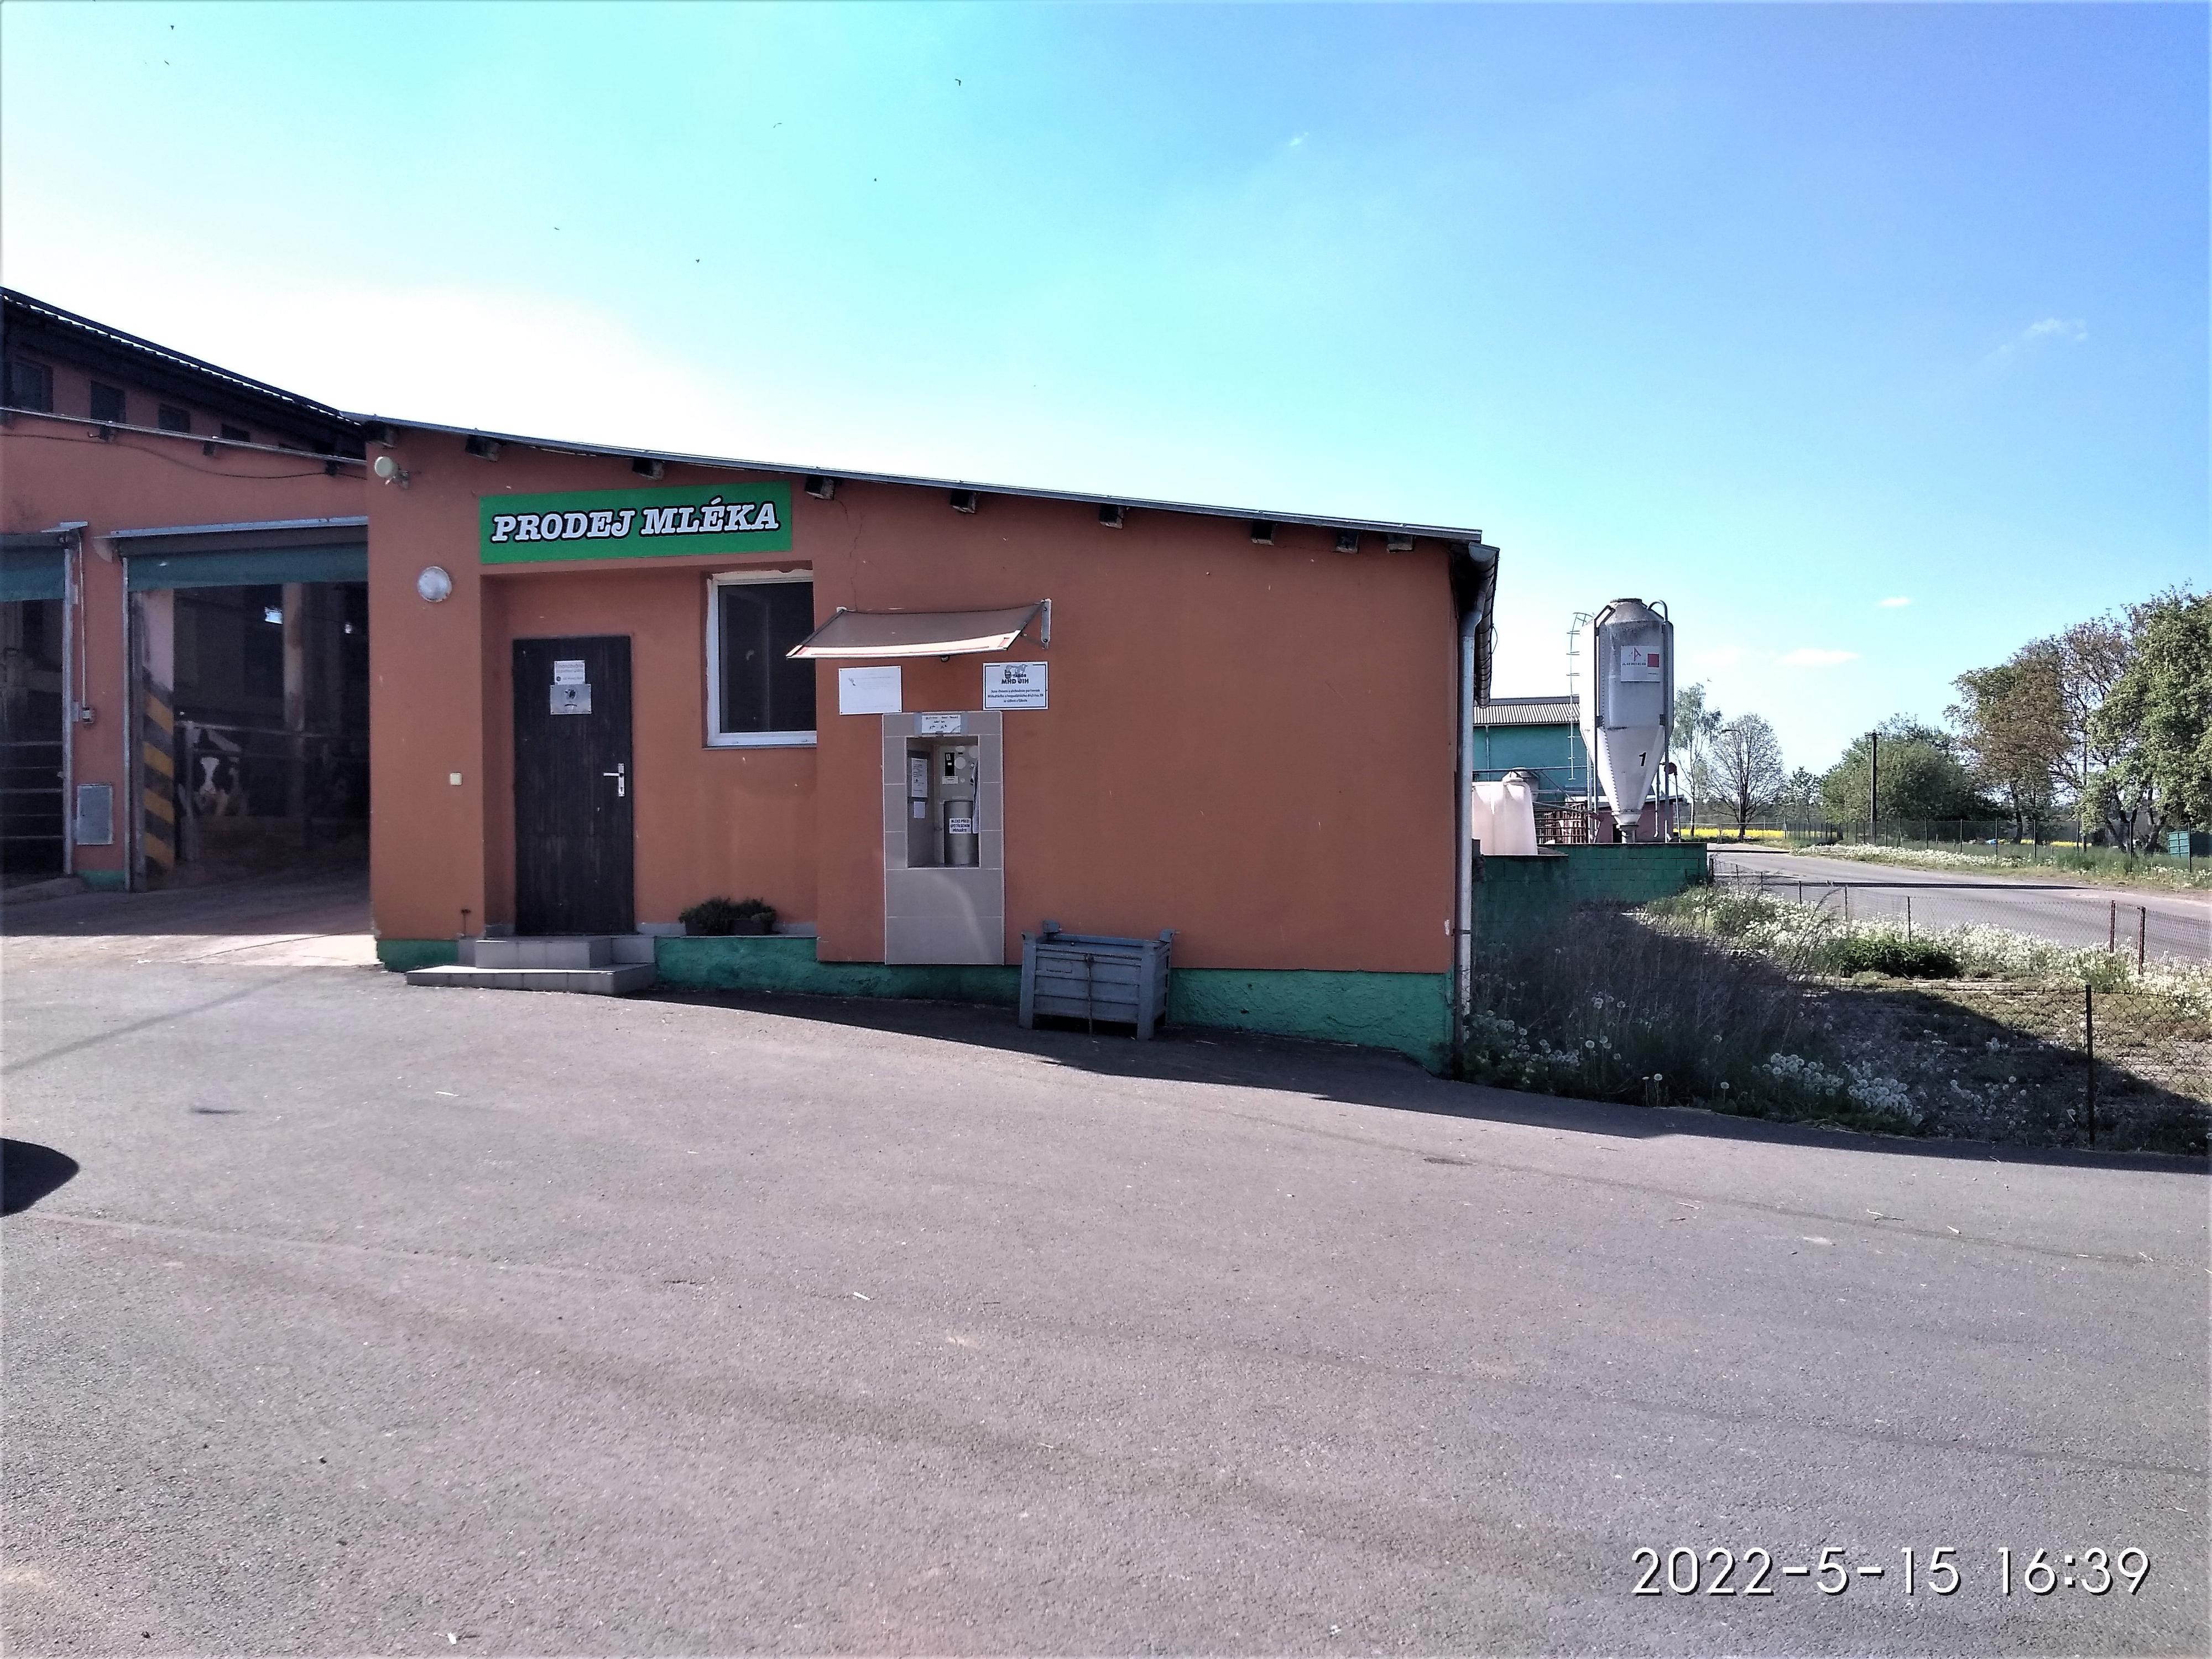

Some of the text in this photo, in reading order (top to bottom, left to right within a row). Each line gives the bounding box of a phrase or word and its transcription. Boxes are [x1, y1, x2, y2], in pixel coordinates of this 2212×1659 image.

[491, 496, 780, 543] PRODEJ MLÉKA
[1639, 752, 1647, 767] 1
